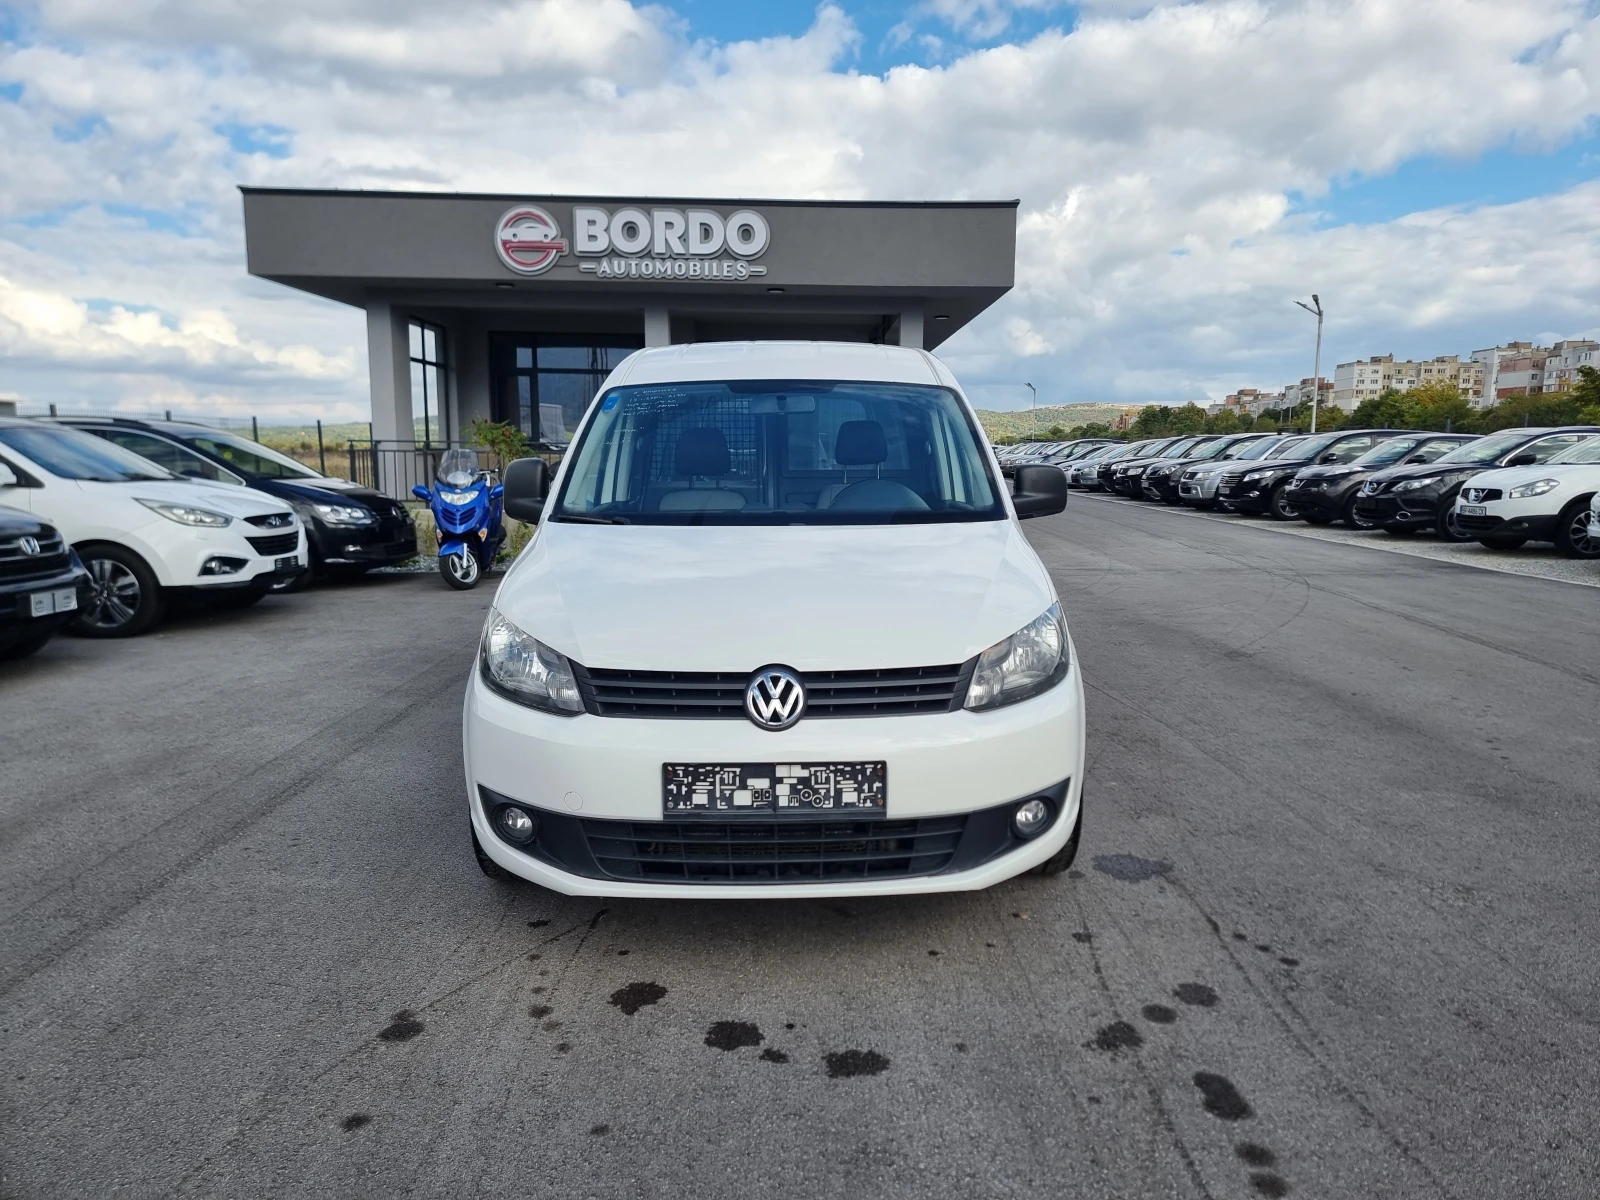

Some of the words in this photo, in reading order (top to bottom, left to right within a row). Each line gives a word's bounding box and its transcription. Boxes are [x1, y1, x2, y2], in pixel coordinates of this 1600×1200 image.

[575, 208, 767, 257] BORDO
[599, 260, 747, 277] AUTOMOBILES
[748, 673, 803, 725] VW
